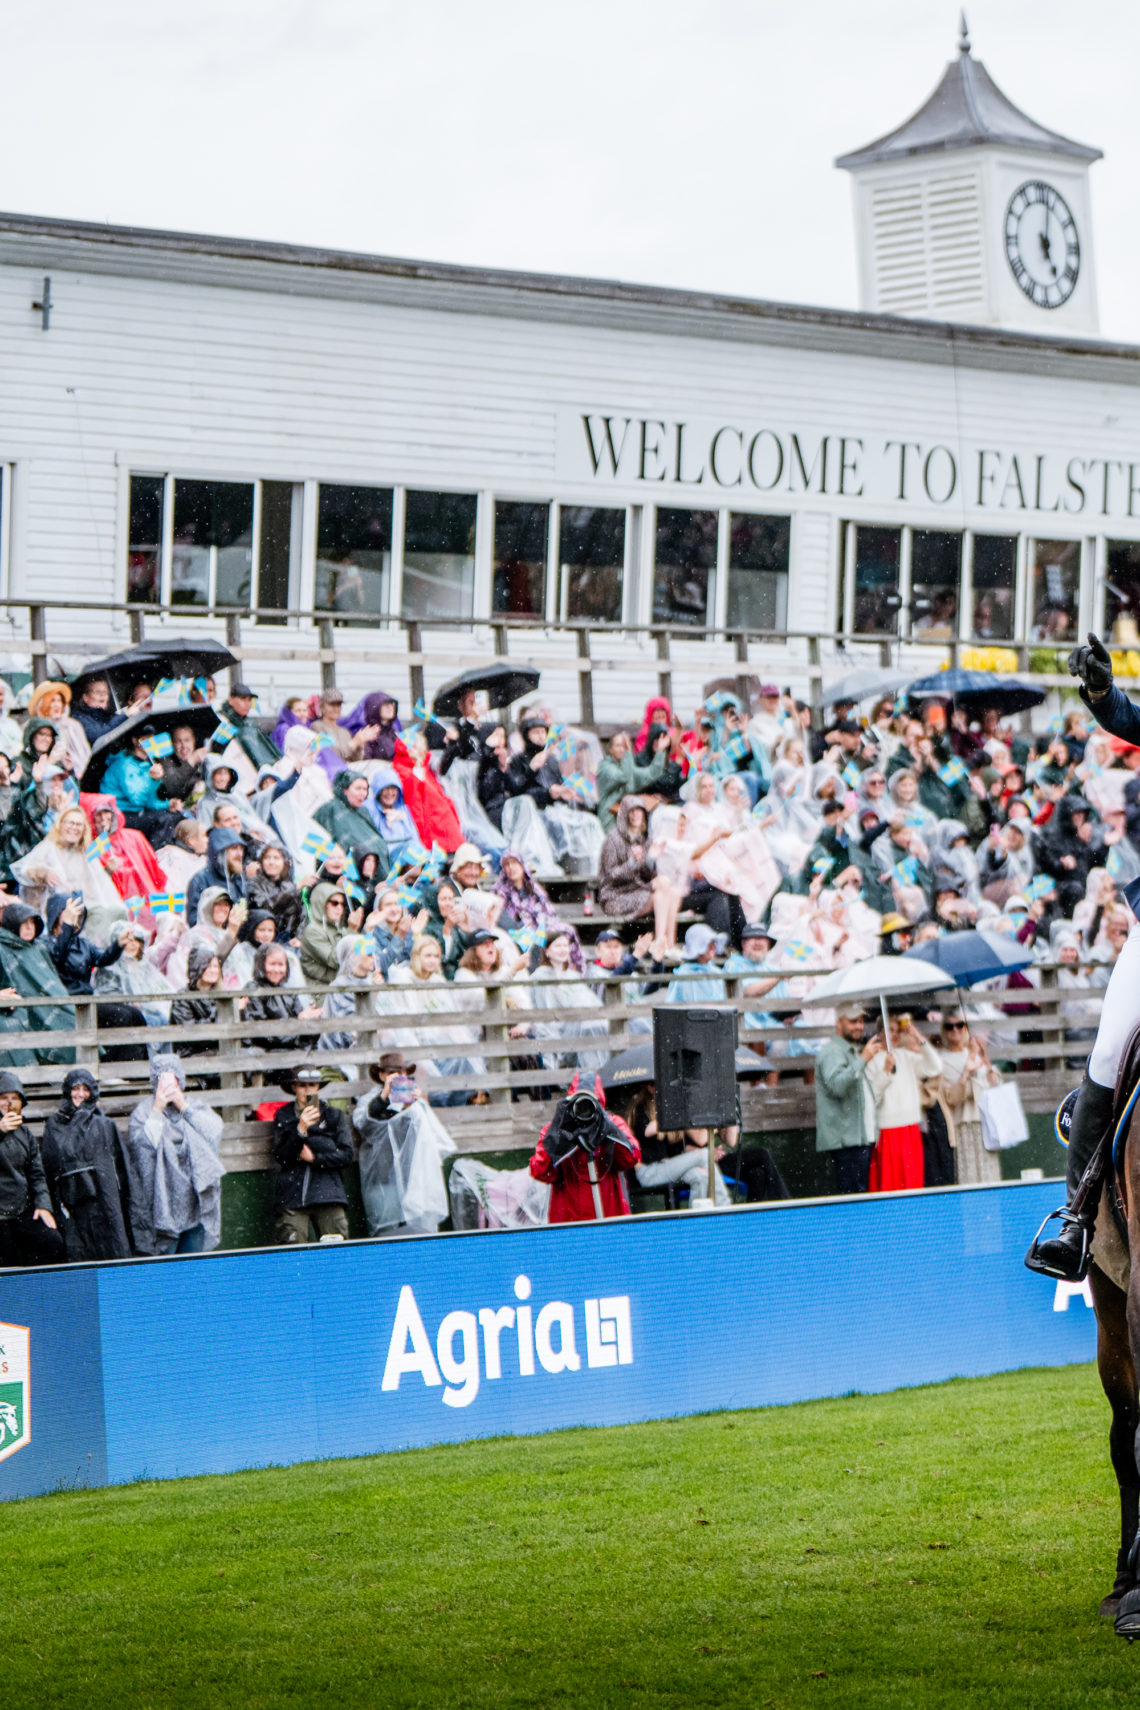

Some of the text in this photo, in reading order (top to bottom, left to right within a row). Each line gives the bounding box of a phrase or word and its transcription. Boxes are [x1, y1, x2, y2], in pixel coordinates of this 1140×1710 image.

[581, 414, 865, 496] WELCOME
[884, 440, 958, 504] TO
[1060, 1111, 1073, 1129] Fo
[380, 1273, 581, 1408] Agria
